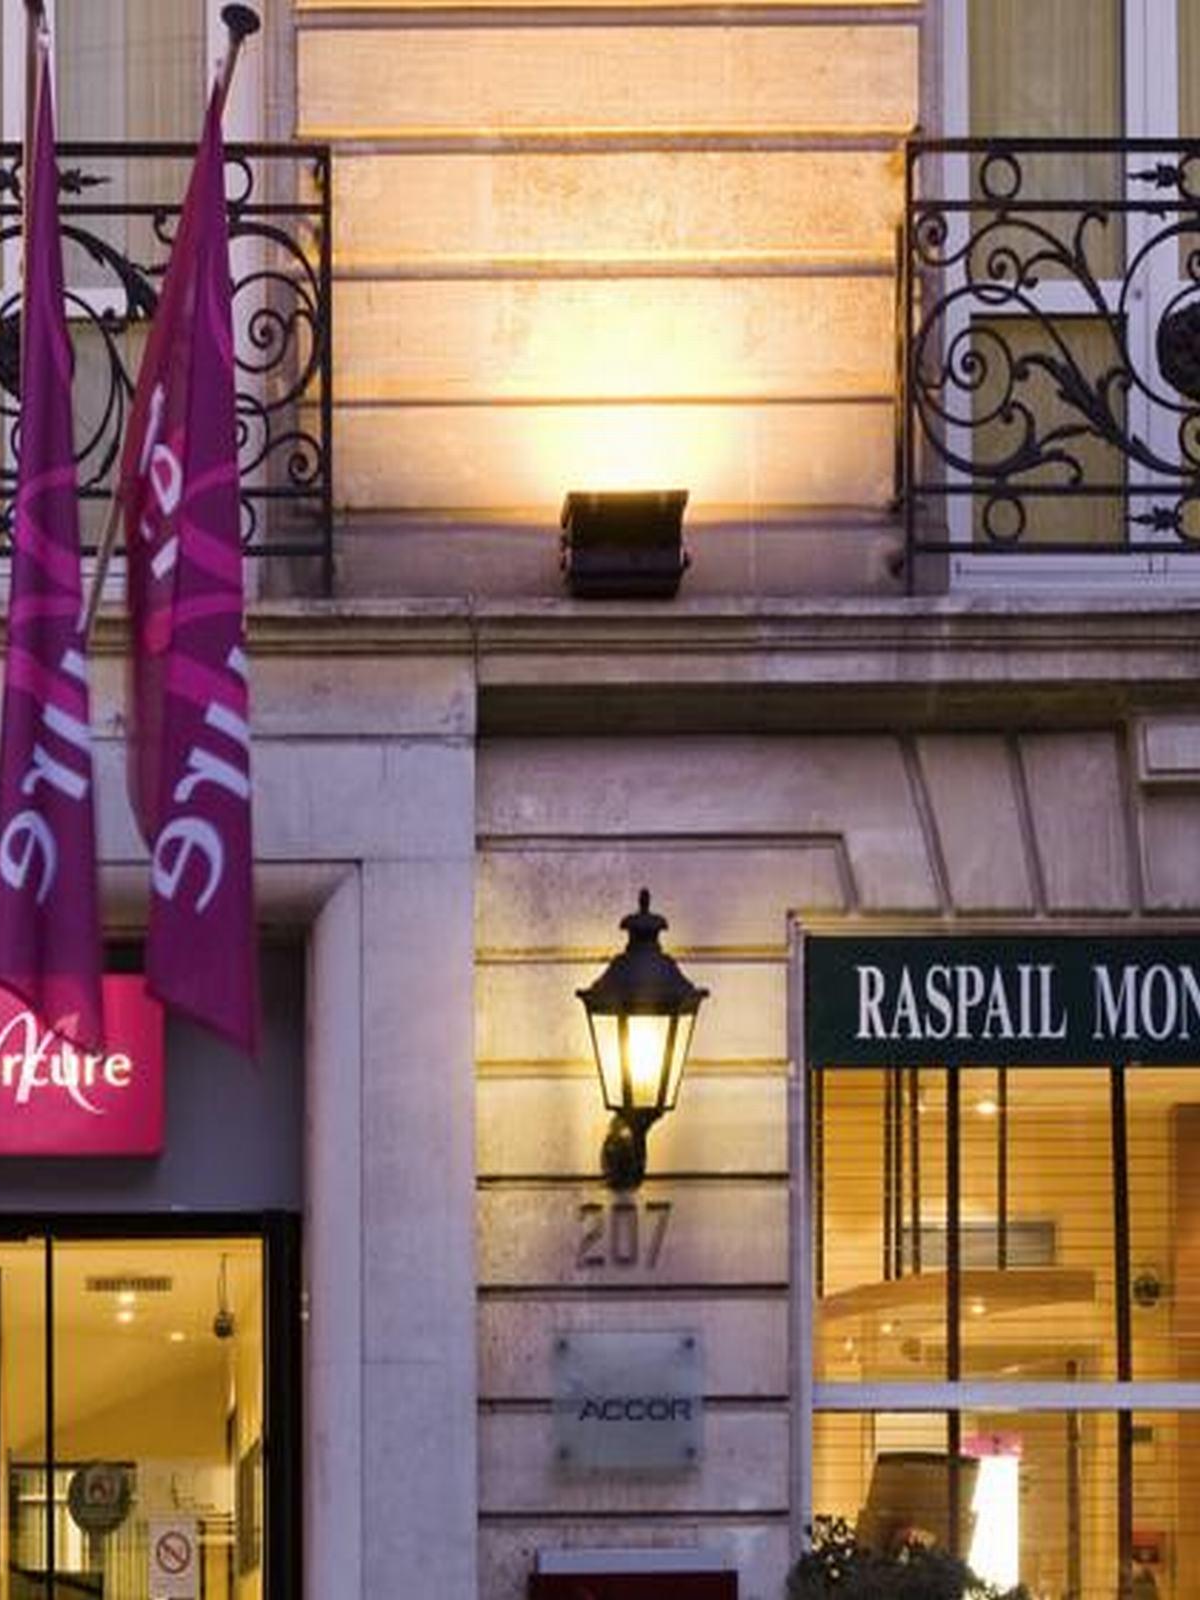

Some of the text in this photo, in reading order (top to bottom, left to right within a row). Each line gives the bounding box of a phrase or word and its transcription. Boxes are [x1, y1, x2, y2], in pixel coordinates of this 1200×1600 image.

[856, 964, 1067, 1039] RASPAIL
[573, 1202, 670, 1270] 207
[579, 1398, 692, 1421] ACCOR
